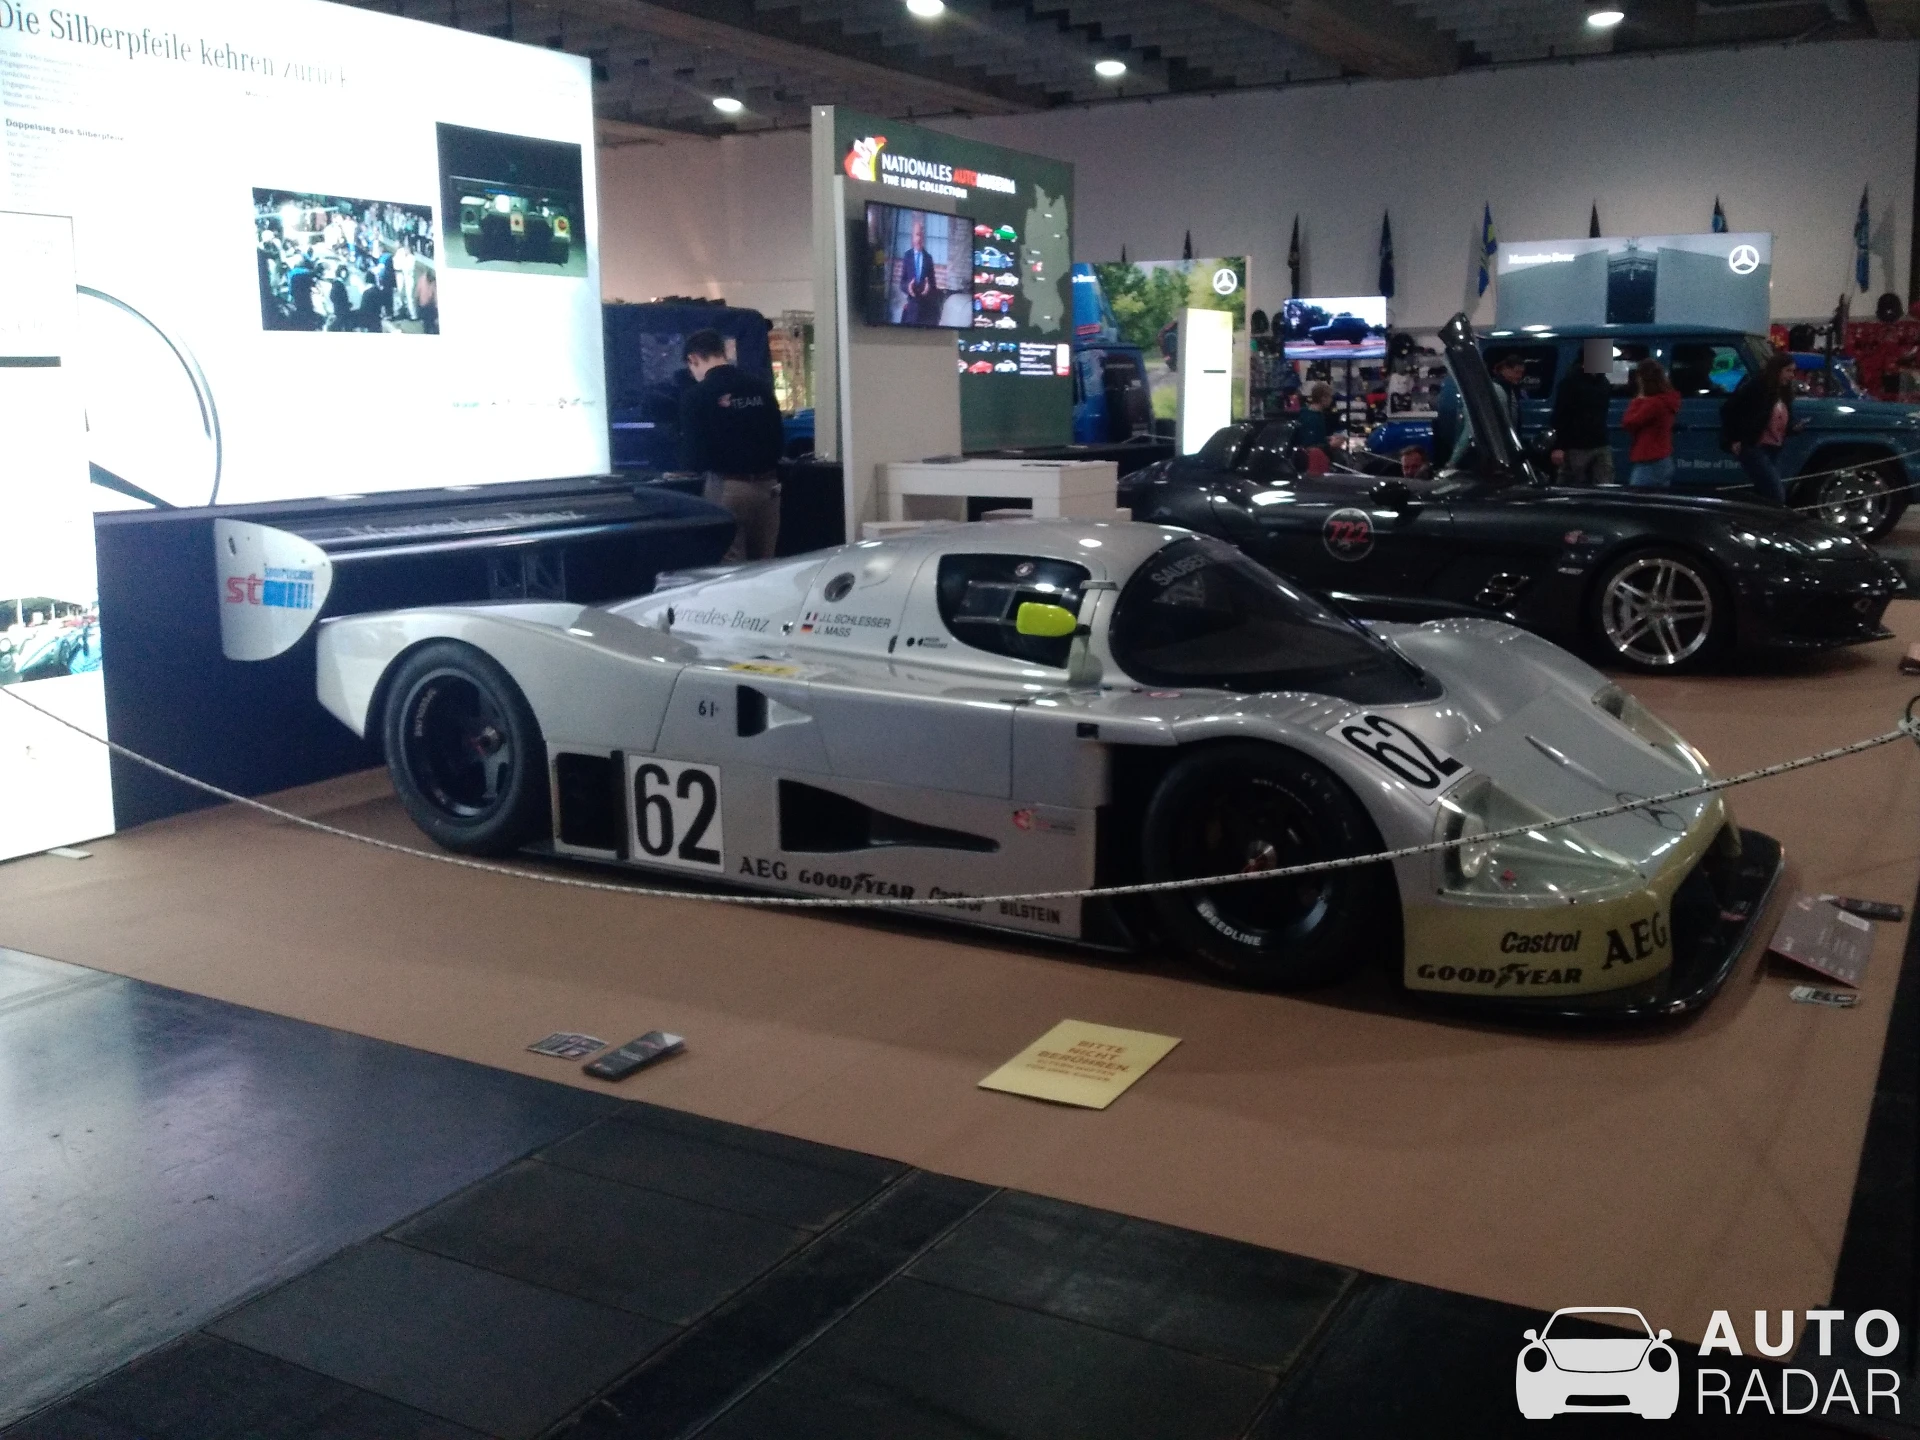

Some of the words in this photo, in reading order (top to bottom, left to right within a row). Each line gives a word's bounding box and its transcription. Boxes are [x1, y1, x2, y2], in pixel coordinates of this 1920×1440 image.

[0, 0, 40, 35] Die
[50, 9, 191, 61] Silberpfeile
[200, 39, 274, 76] kehren
[5, 118, 56, 134] Doppelsieg
[881, 153, 952, 183] NATIONALES
[882, 173, 899, 187] THE
[919, 180, 968, 199] COLLECTION
[731, 395, 764, 409] TEAM
[1327, 520, 1369, 543] 722
[673, 604, 770, 633] ercedes-Benz
[824, 625, 852, 637] MASS
[1341, 715, 1464, 789] 62
[634, 763, 720, 865] 62
[739, 856, 788, 881] AEG
[798, 873, 915, 900] GOODYEAR
[1000, 901, 1060, 924] BILSTEIN
[1197, 903, 1261, 946] SPEEDLINE
[1500, 930, 1582, 953] Castrol
[1602, 912, 1667, 969] AEG
[1417, 963, 1582, 988] GOODYEAR
[1068, 1047, 1120, 1060] NICHT
[1078, 1040, 1126, 1053] BITTE
